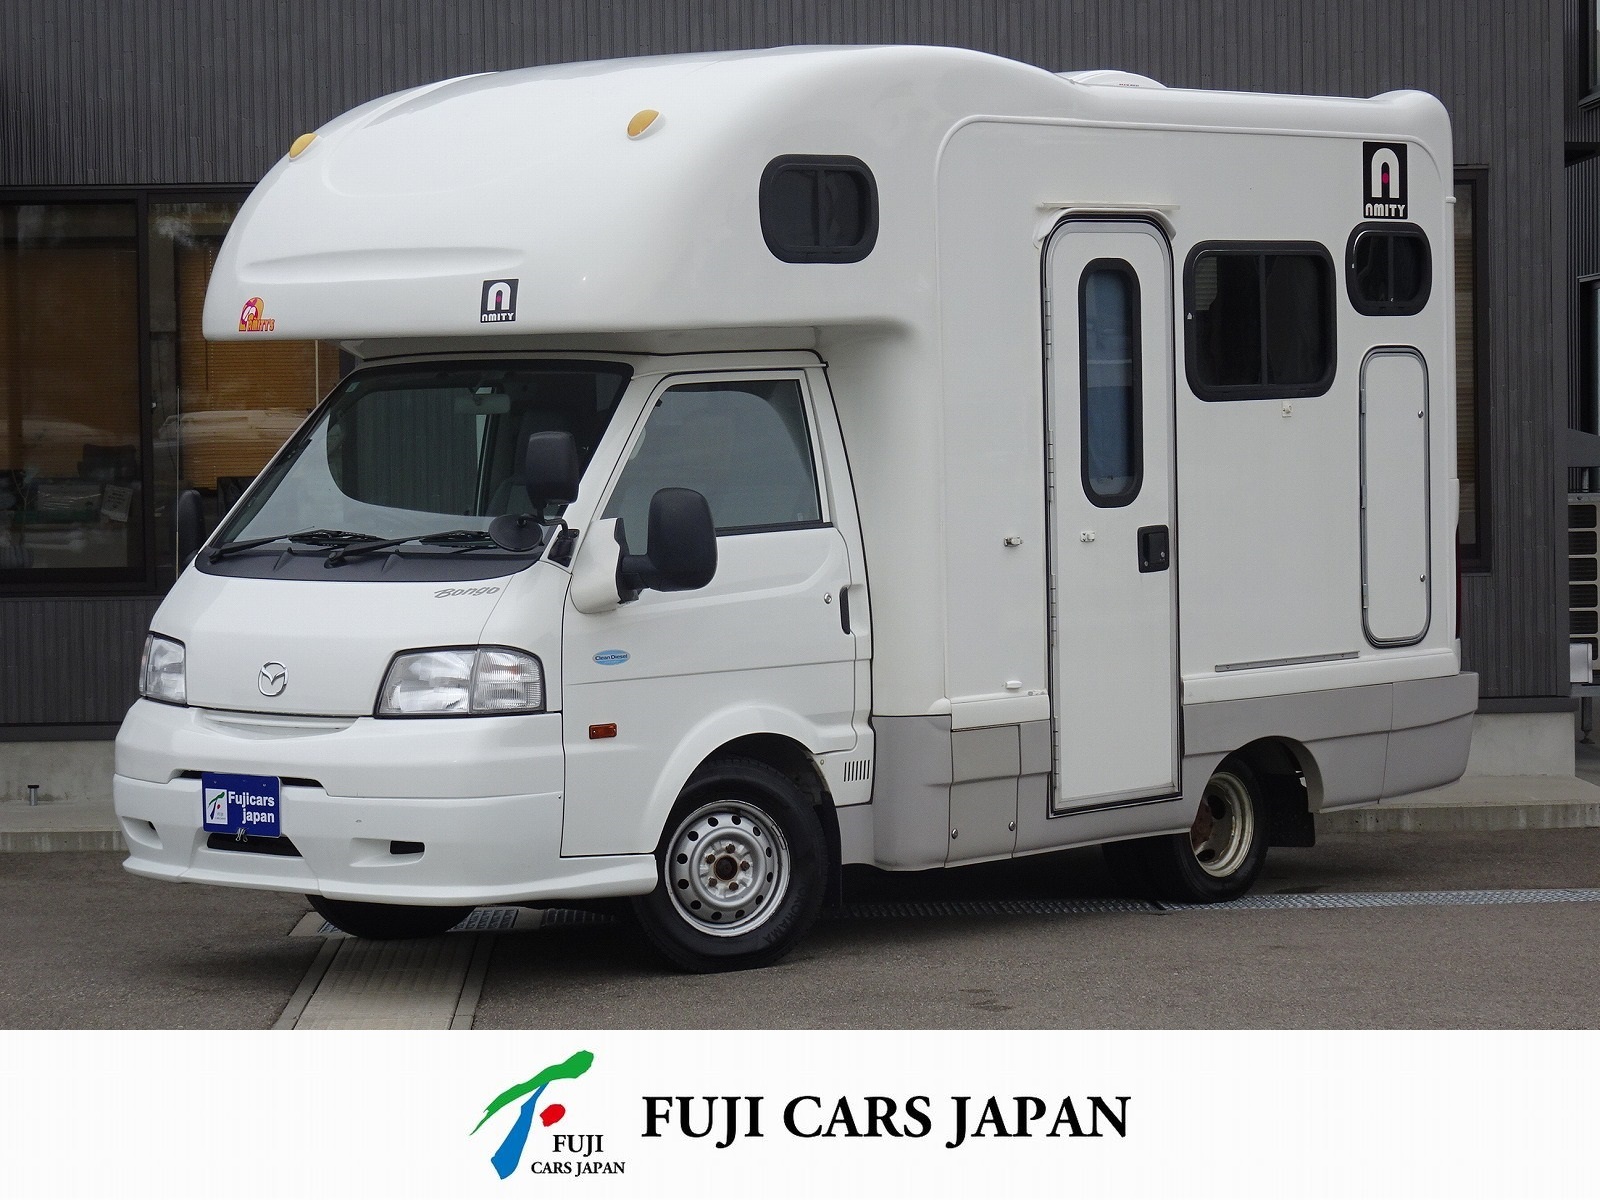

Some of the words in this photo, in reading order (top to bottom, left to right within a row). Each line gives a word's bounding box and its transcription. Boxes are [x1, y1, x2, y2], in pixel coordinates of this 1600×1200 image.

[1365, 203, 1406, 217] AMITY
[434, 586, 501, 599] Bongo
[228, 791, 275, 808] Fujicars
[241, 808, 275, 825] japan
